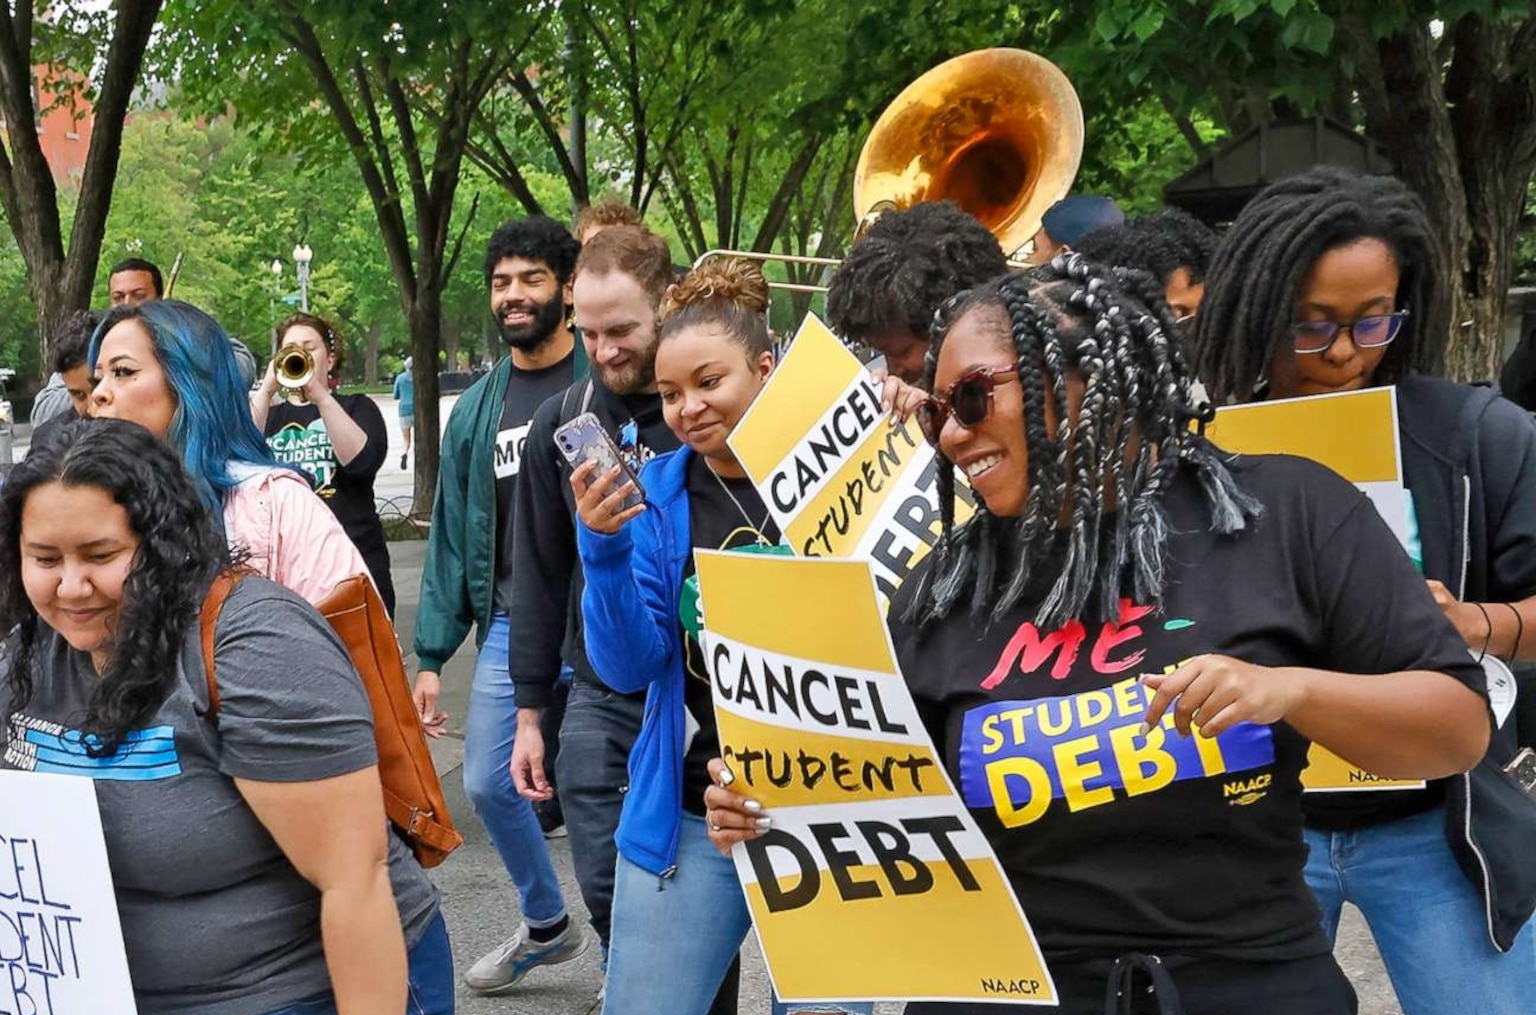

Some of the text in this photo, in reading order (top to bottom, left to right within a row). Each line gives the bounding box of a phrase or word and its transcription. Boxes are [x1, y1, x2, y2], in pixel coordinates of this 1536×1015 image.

[273, 446, 333, 463] TUDENT
[713, 642, 909, 735] CANCEL
[10, 712, 64, 736] ALLIANCE
[4, 747, 38, 771] ACTION
[722, 745, 933, 793] STUDENT
[1223, 774, 1272, 797] NAACP
[744, 815, 982, 914] DEBT
[981, 978, 1040, 995] NAACP
